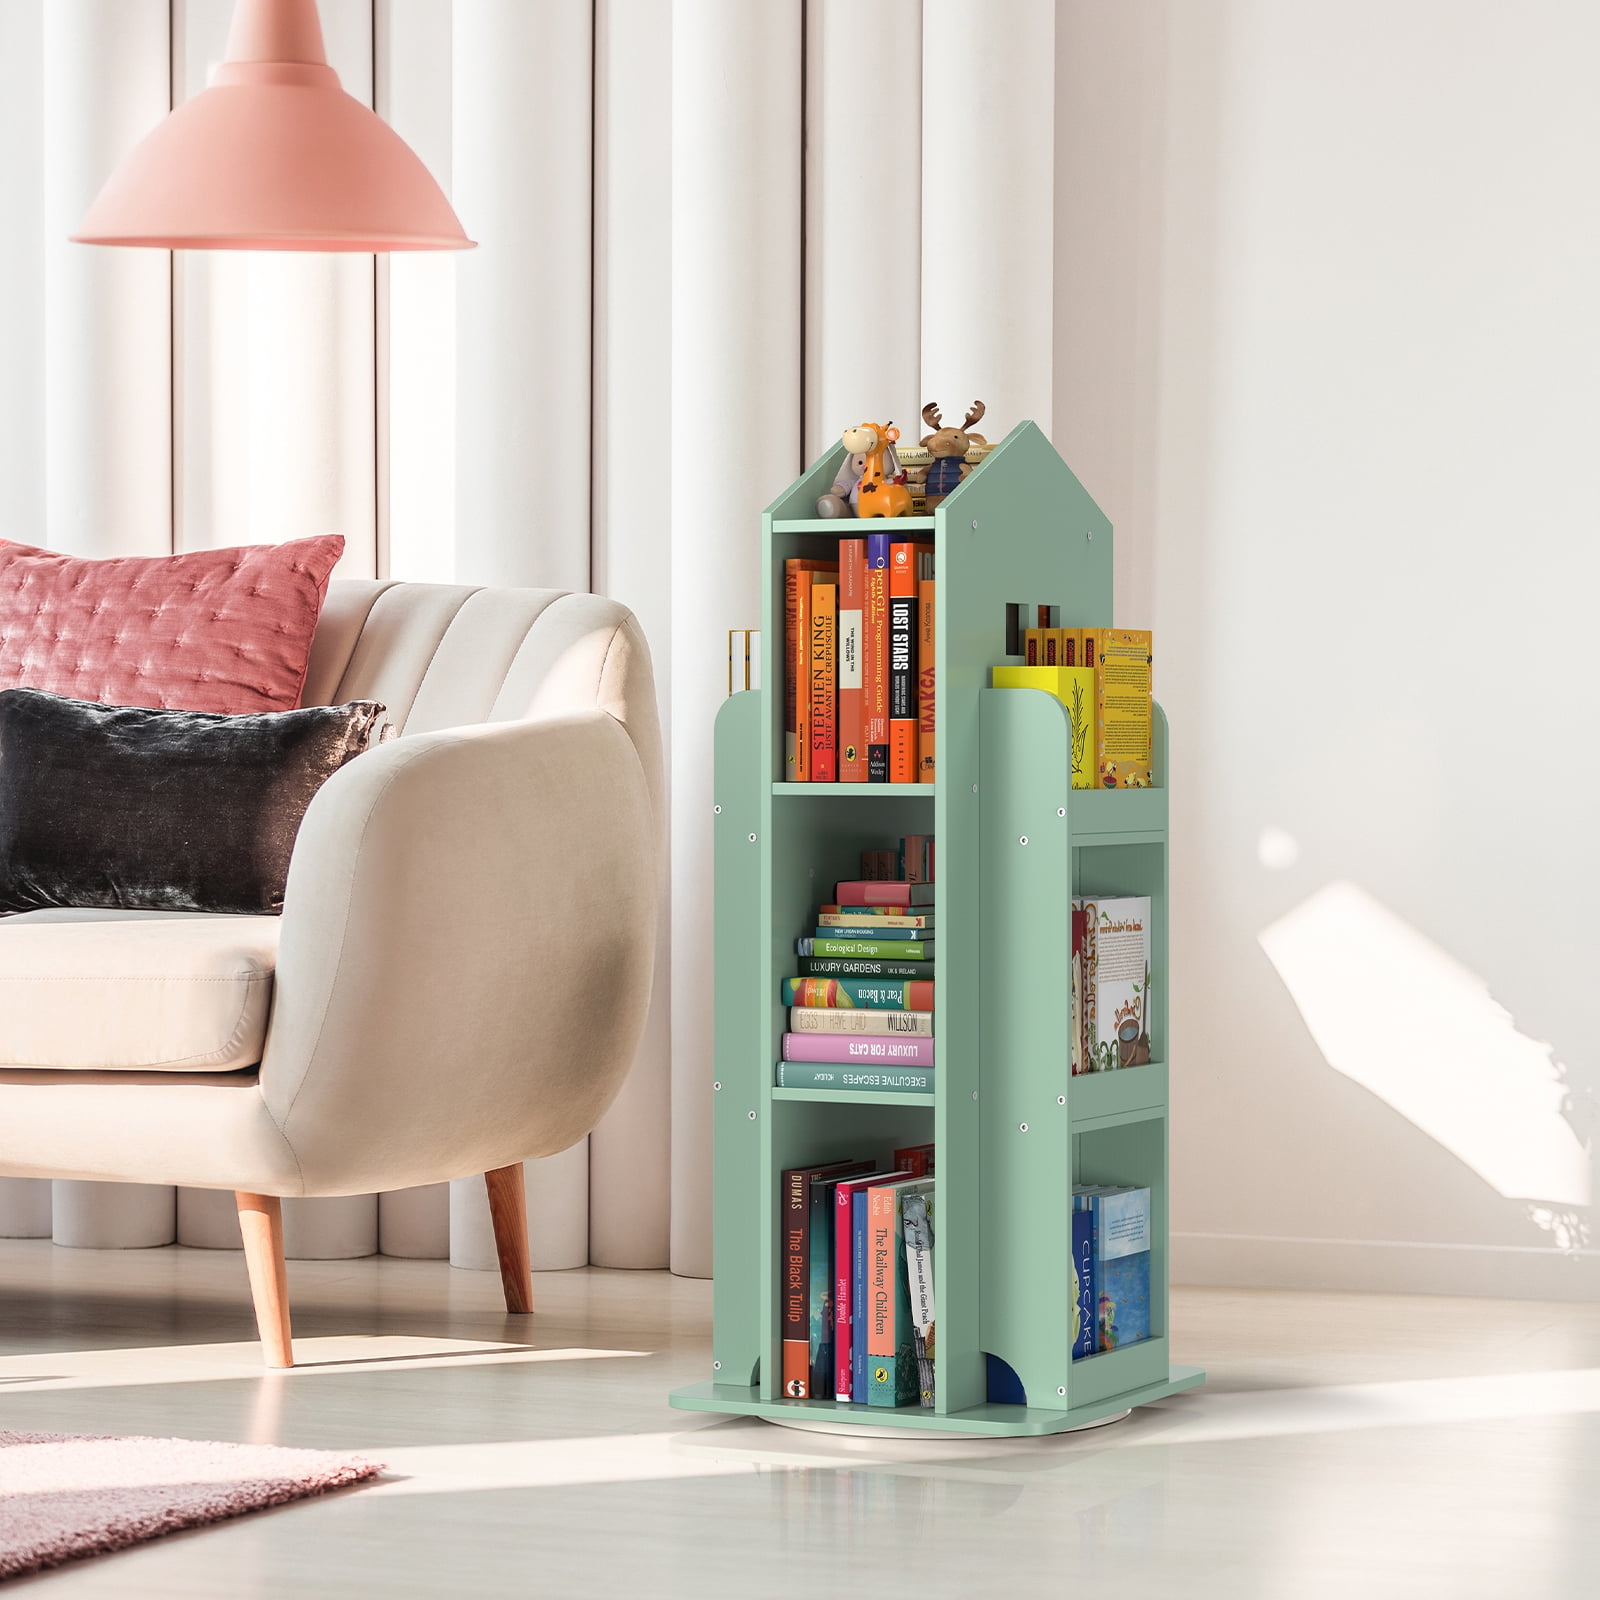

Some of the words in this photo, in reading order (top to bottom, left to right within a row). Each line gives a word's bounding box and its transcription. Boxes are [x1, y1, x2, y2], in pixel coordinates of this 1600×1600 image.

[874, 556, 885, 617] OpenGL
[892, 603, 909, 630] LOST
[813, 615, 825, 660] KING
[874, 620, 883, 683] Programming
[892, 634, 909, 670] STARS
[825, 676, 832, 686] LE
[813, 669, 825, 750] STEPHEN
[825, 721, 833, 750] JUSTE
[825, 942, 856, 954] Ecological
[857, 944, 878, 955] Design
[810, 962, 841, 972] LUXURY
[843, 963, 881, 973] GARDENS
[858, 989, 879, 1003] Bacon
[880, 990, 886, 1003] &
[884, 990, 903, 1004] Pear
[800, 1011, 818, 1030] EGGS
[887, 1013, 918, 1032] WILLSON
[849, 1043, 869, 1055] CATS
[870, 1044, 885, 1056] FOR
[888, 1044, 918, 1057] LUXURY
[843, 1074, 880, 1086] ESCAPES
[882, 1075, 926, 1087] EXECUTIVE
[791, 1175, 802, 1210] DUMAS
[872, 1194, 881, 1216] Nesbit
[883, 1196, 892, 1214] Edith
[789, 1228, 803, 1251] The
[876, 1228, 888, 1247] The
[789, 1255, 803, 1289] Black
[872, 1249, 888, 1289] Railway
[916, 1258, 924, 1273] James
[918, 1274, 926, 1284] and
[837, 1279, 847, 1301] Hamlet
[1082, 1240, 1092, 1353] CUPCAKE
[788, 1293, 803, 1322] Tulip
[920, 1293, 928, 1308] Giant
[837, 1303, 847, 1324] Double
[875, 1291, 888, 1335] Children
[921, 1308, 930, 1325] Peach
